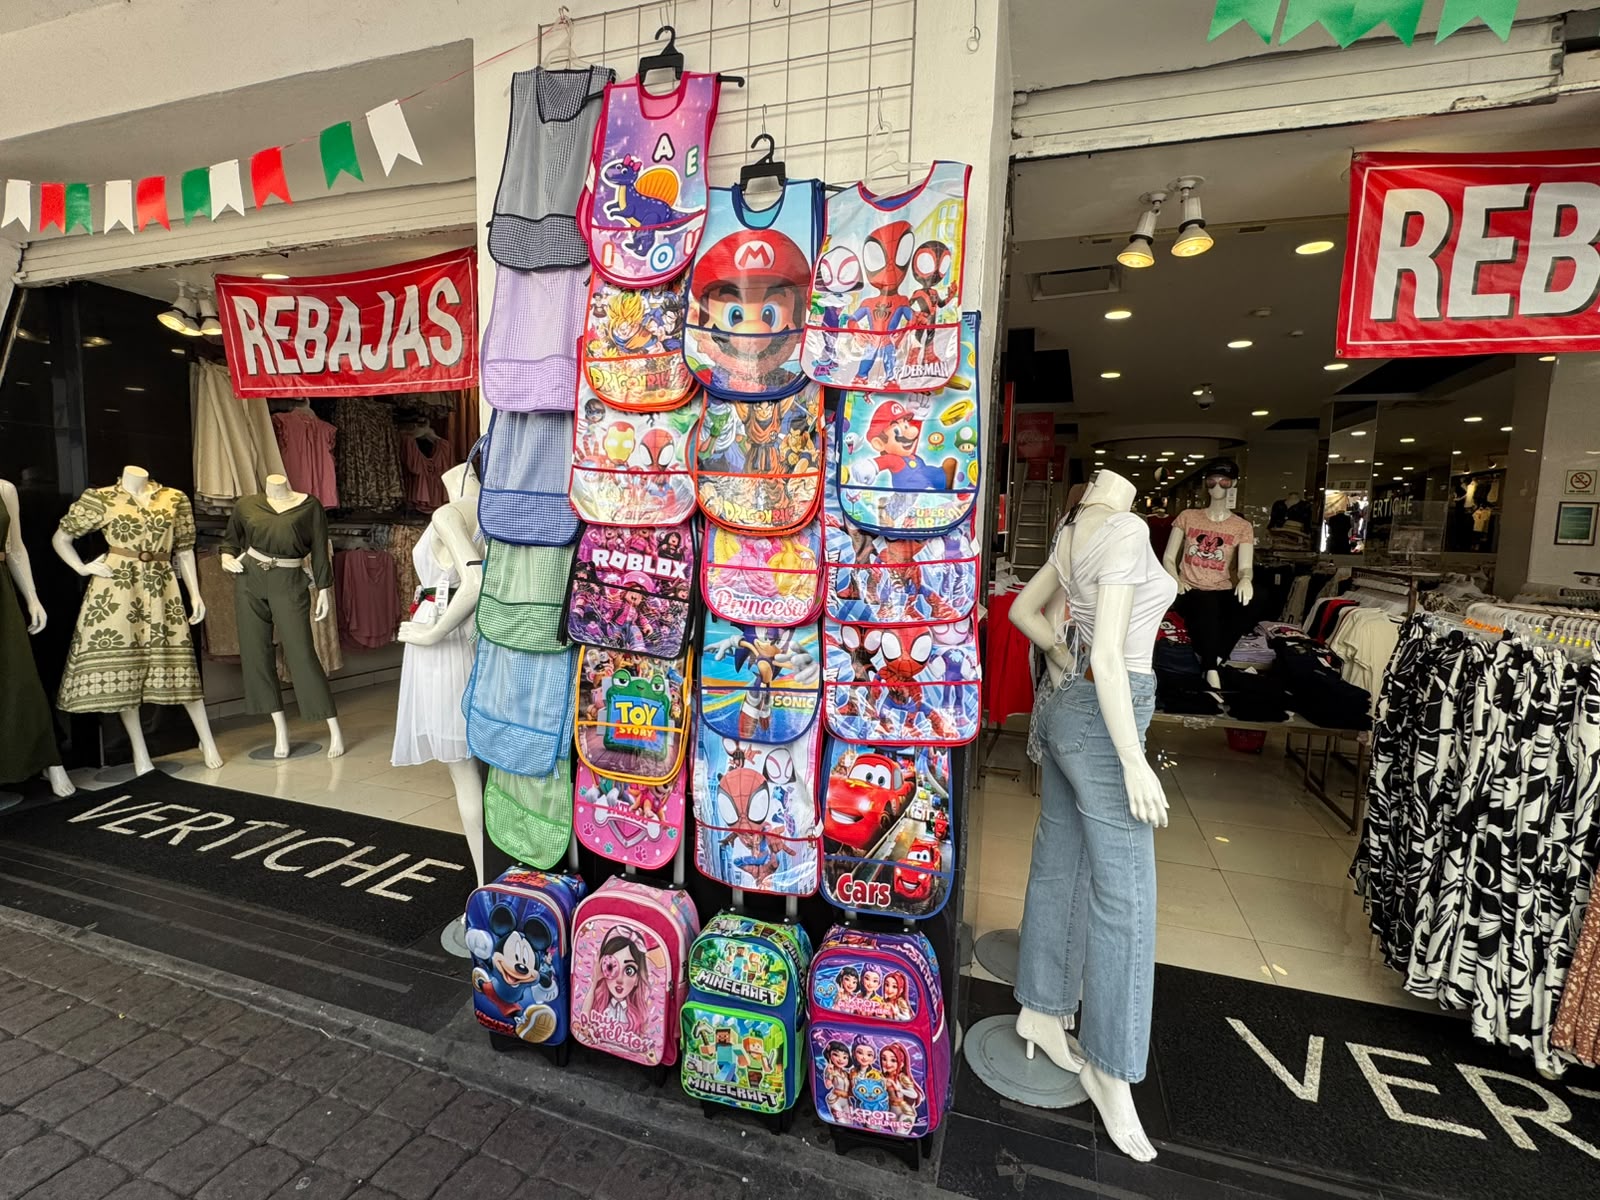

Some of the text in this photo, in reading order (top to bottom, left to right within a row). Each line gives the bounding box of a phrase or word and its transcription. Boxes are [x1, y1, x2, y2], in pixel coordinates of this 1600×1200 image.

[652, 133, 675, 163] A
[685, 145, 699, 178] E
[602, 242, 614, 268] I
[651, 243, 675, 272] O
[738, 244, 771, 268] M
[1370, 182, 1600, 322] REB
[231, 277, 463, 375] REBAJAS
[908, 508, 945, 519] SUPER
[1370, 494, 1414, 518] ERTICHE
[592, 549, 689, 580] ROBLOX
[1184, 553, 1226, 572] MOUSE
[615, 701, 657, 726] TOY
[773, 695, 815, 708] SONIC
[619, 725, 654, 738] STORY
[67, 795, 464, 902] VERTICHE
[836, 872, 891, 907] Cars
[697, 969, 778, 1005] MINECRAFT
[688, 1077, 778, 1108] MINECRAFT
[1225, 1017, 1600, 1159] VER
[849, 1106, 897, 1121] KPOP
